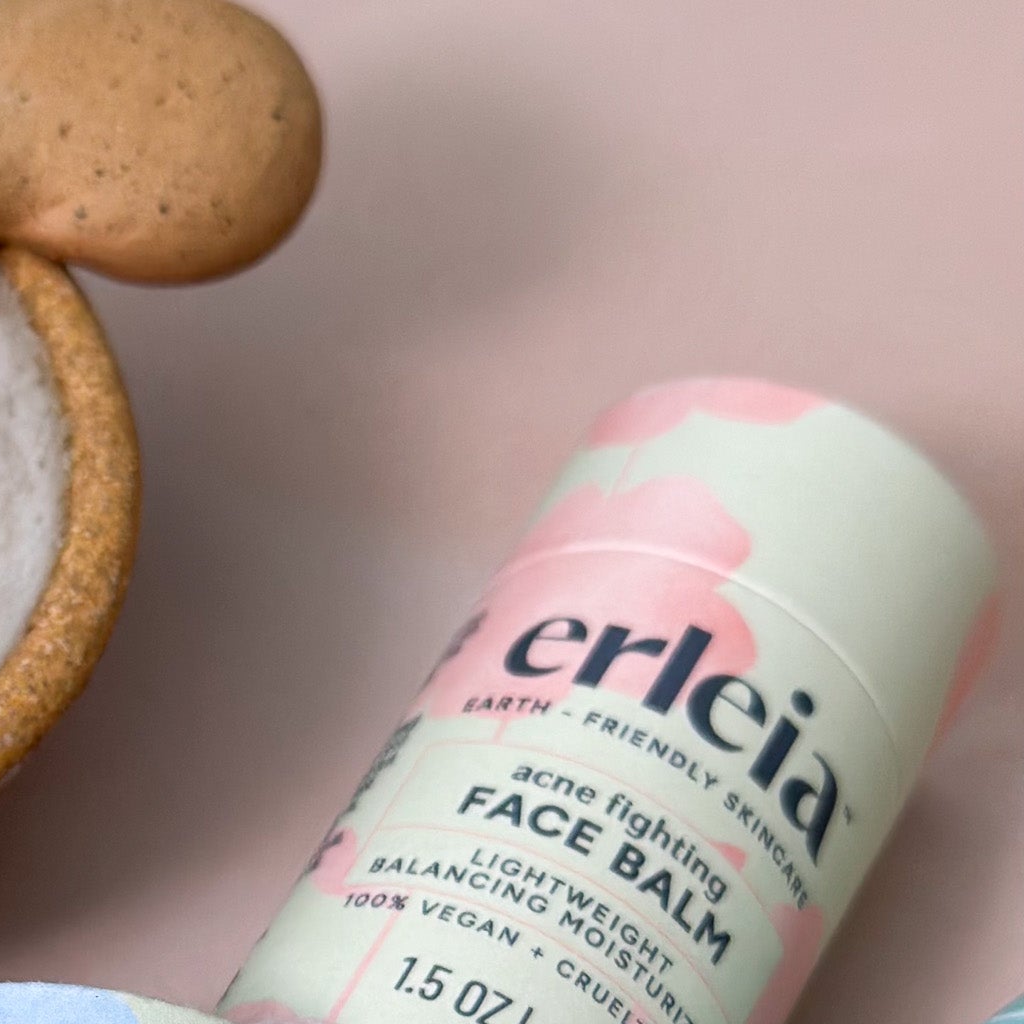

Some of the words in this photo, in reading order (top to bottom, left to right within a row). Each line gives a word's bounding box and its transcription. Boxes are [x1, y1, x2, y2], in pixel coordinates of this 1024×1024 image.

[462, 696, 553, 716] EARTH
[582, 711, 717, 791] FRIENDLY
[723, 793, 808, 911] SKINCARE
[503, 615, 838, 868] erleia
[368, 857, 549, 915] BALANCING
[457, 785, 605, 857] FACE
[608, 846, 731, 967] BALM
[511, 763, 596, 804] acne
[607, 793, 728, 903] fighting
[344, 891, 407, 912] 100%
[421, 900, 521, 948] VEGAN
[469, 847, 676, 975] LIGHTWEIGHT
[392, 955, 452, 1002] 1.5
